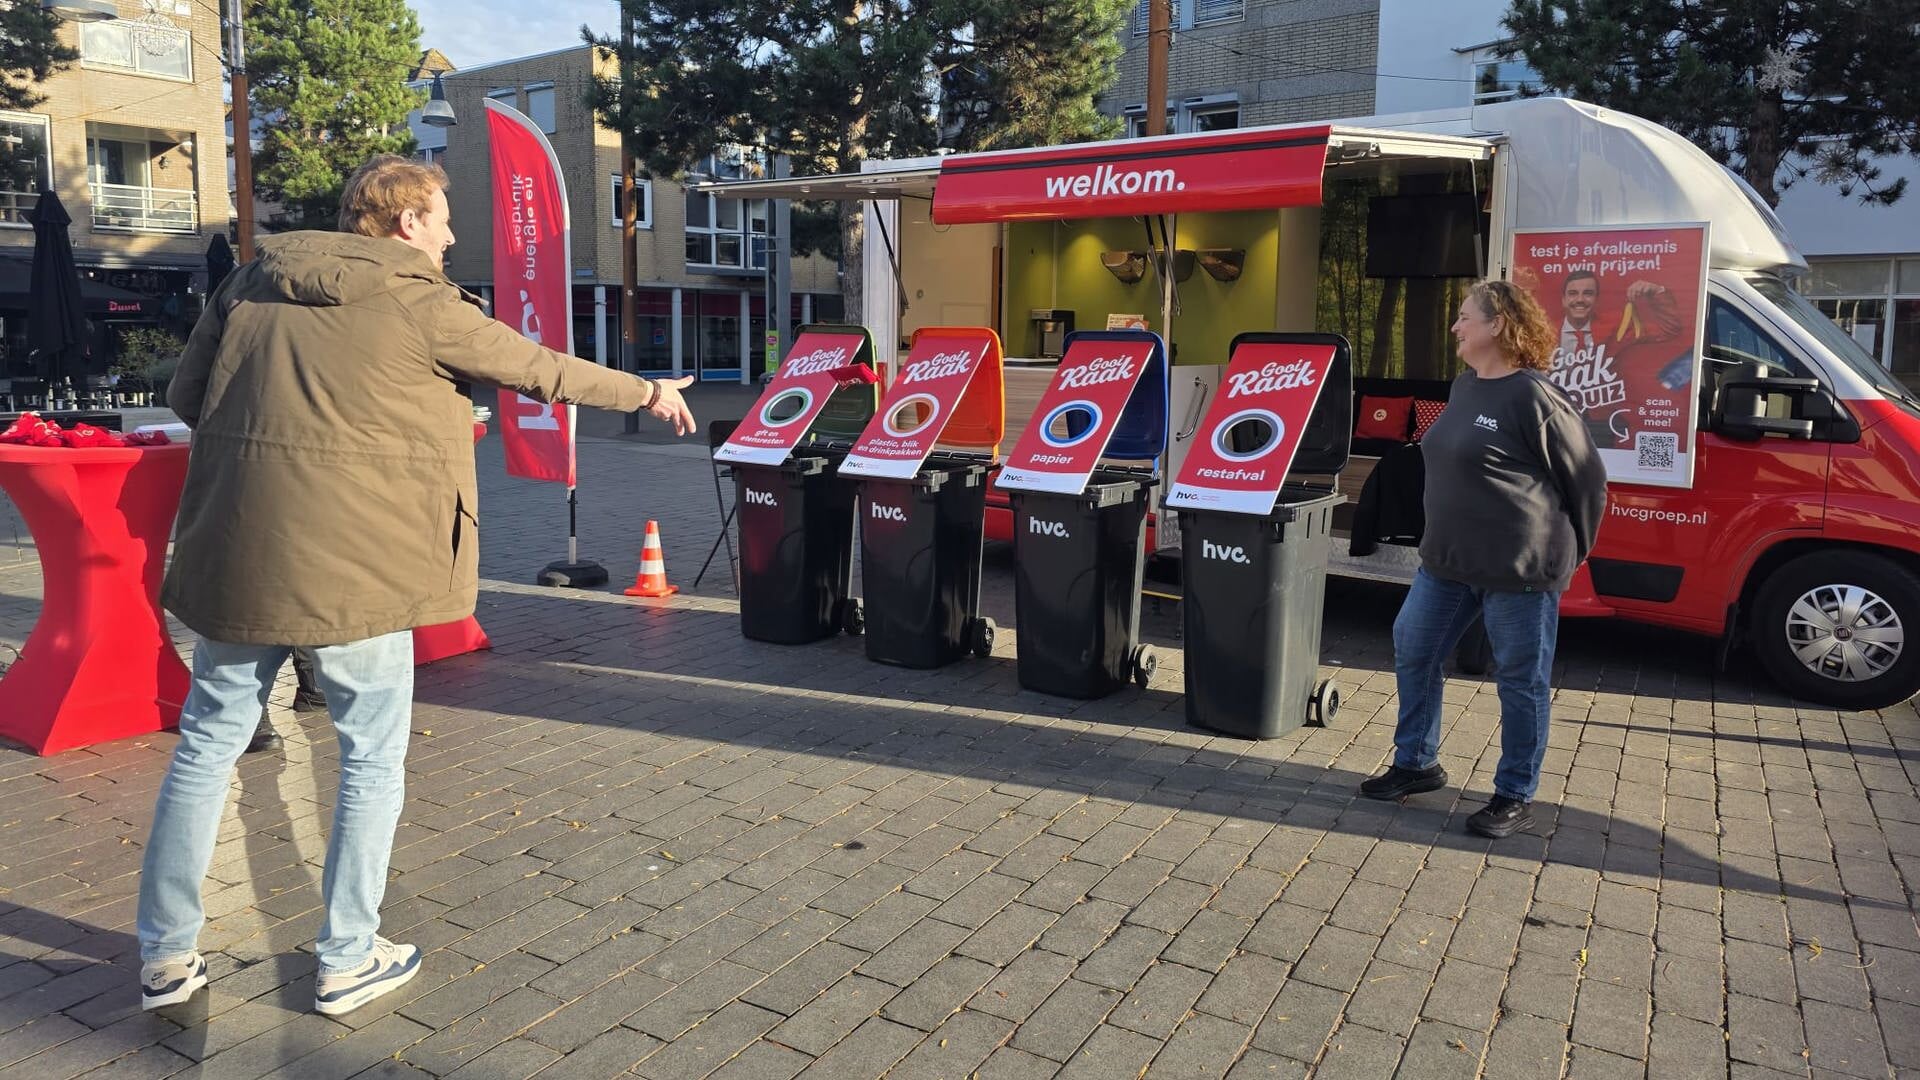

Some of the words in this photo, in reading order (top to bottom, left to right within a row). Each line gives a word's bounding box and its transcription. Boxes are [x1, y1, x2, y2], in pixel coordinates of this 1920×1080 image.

[1046, 165, 1186, 198] welkom.
[1530, 244, 1560, 257] test
[1563, 243, 1579, 259] je
[1583, 240, 1678, 256] afvalkennis
[1543, 263, 1562, 273] en
[1568, 260, 1596, 273] win
[1600, 254, 1661, 277] prijzen!
[108, 300, 141, 311] Duvel
[810, 347, 841, 362] Gooi
[932, 350, 964, 365] Gooi
[1089, 354, 1126, 371] Gooi
[784, 349, 846, 379] Raak
[903, 352, 971, 385] Raak
[1261, 359, 1303, 376] Gooi
[1550, 344, 1617, 389] aak
[1058, 356, 1135, 391] Raak
[1228, 361, 1316, 398] Raak
[1646, 399, 1672, 407] scan
[1638, 407, 1648, 416] &
[1649, 407, 1679, 417] speel
[1475, 414, 1498, 429] hvc.
[1644, 418, 1671, 427] mee!
[740, 436, 785, 445] etensresten
[868, 438, 899, 448] plastic,
[869, 446, 922, 456] drinkpakken
[1030, 454, 1074, 464] papier
[1197, 467, 1265, 480] restafval
[746, 488, 777, 506] hvc.
[872, 502, 907, 521] hvc.
[1611, 502, 1707, 525] hvcgroep.nl
[1029, 516, 1070, 538] hvc.
[1202, 539, 1251, 564] hvc.
